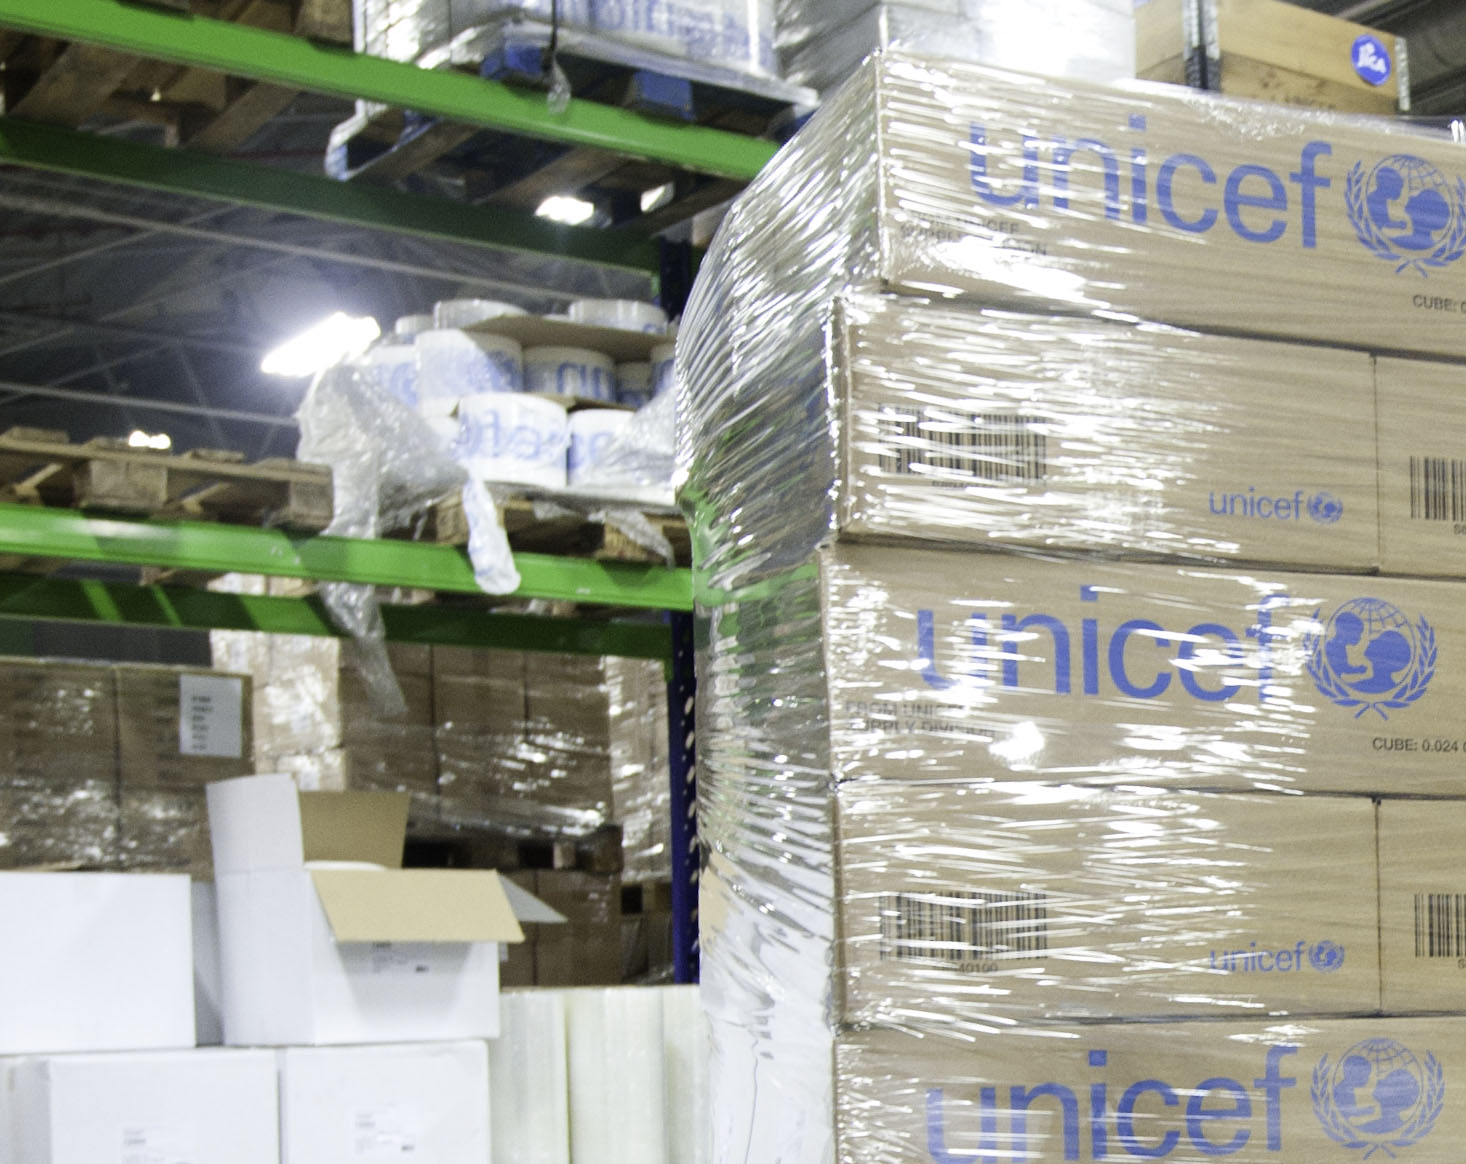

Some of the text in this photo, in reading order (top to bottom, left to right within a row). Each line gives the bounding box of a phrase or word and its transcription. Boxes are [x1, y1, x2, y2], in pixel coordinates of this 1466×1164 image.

[969, 113, 1332, 249] unicef
[1412, 294, 1457, 313] CUBE:
[1209, 486, 1303, 519] unicef
[915, 585, 1300, 704] unicef
[1372, 737, 1418, 751] CUBE:
[1422, 739, 1458, 752] 0.024
[1209, 940, 1305, 973] unicef
